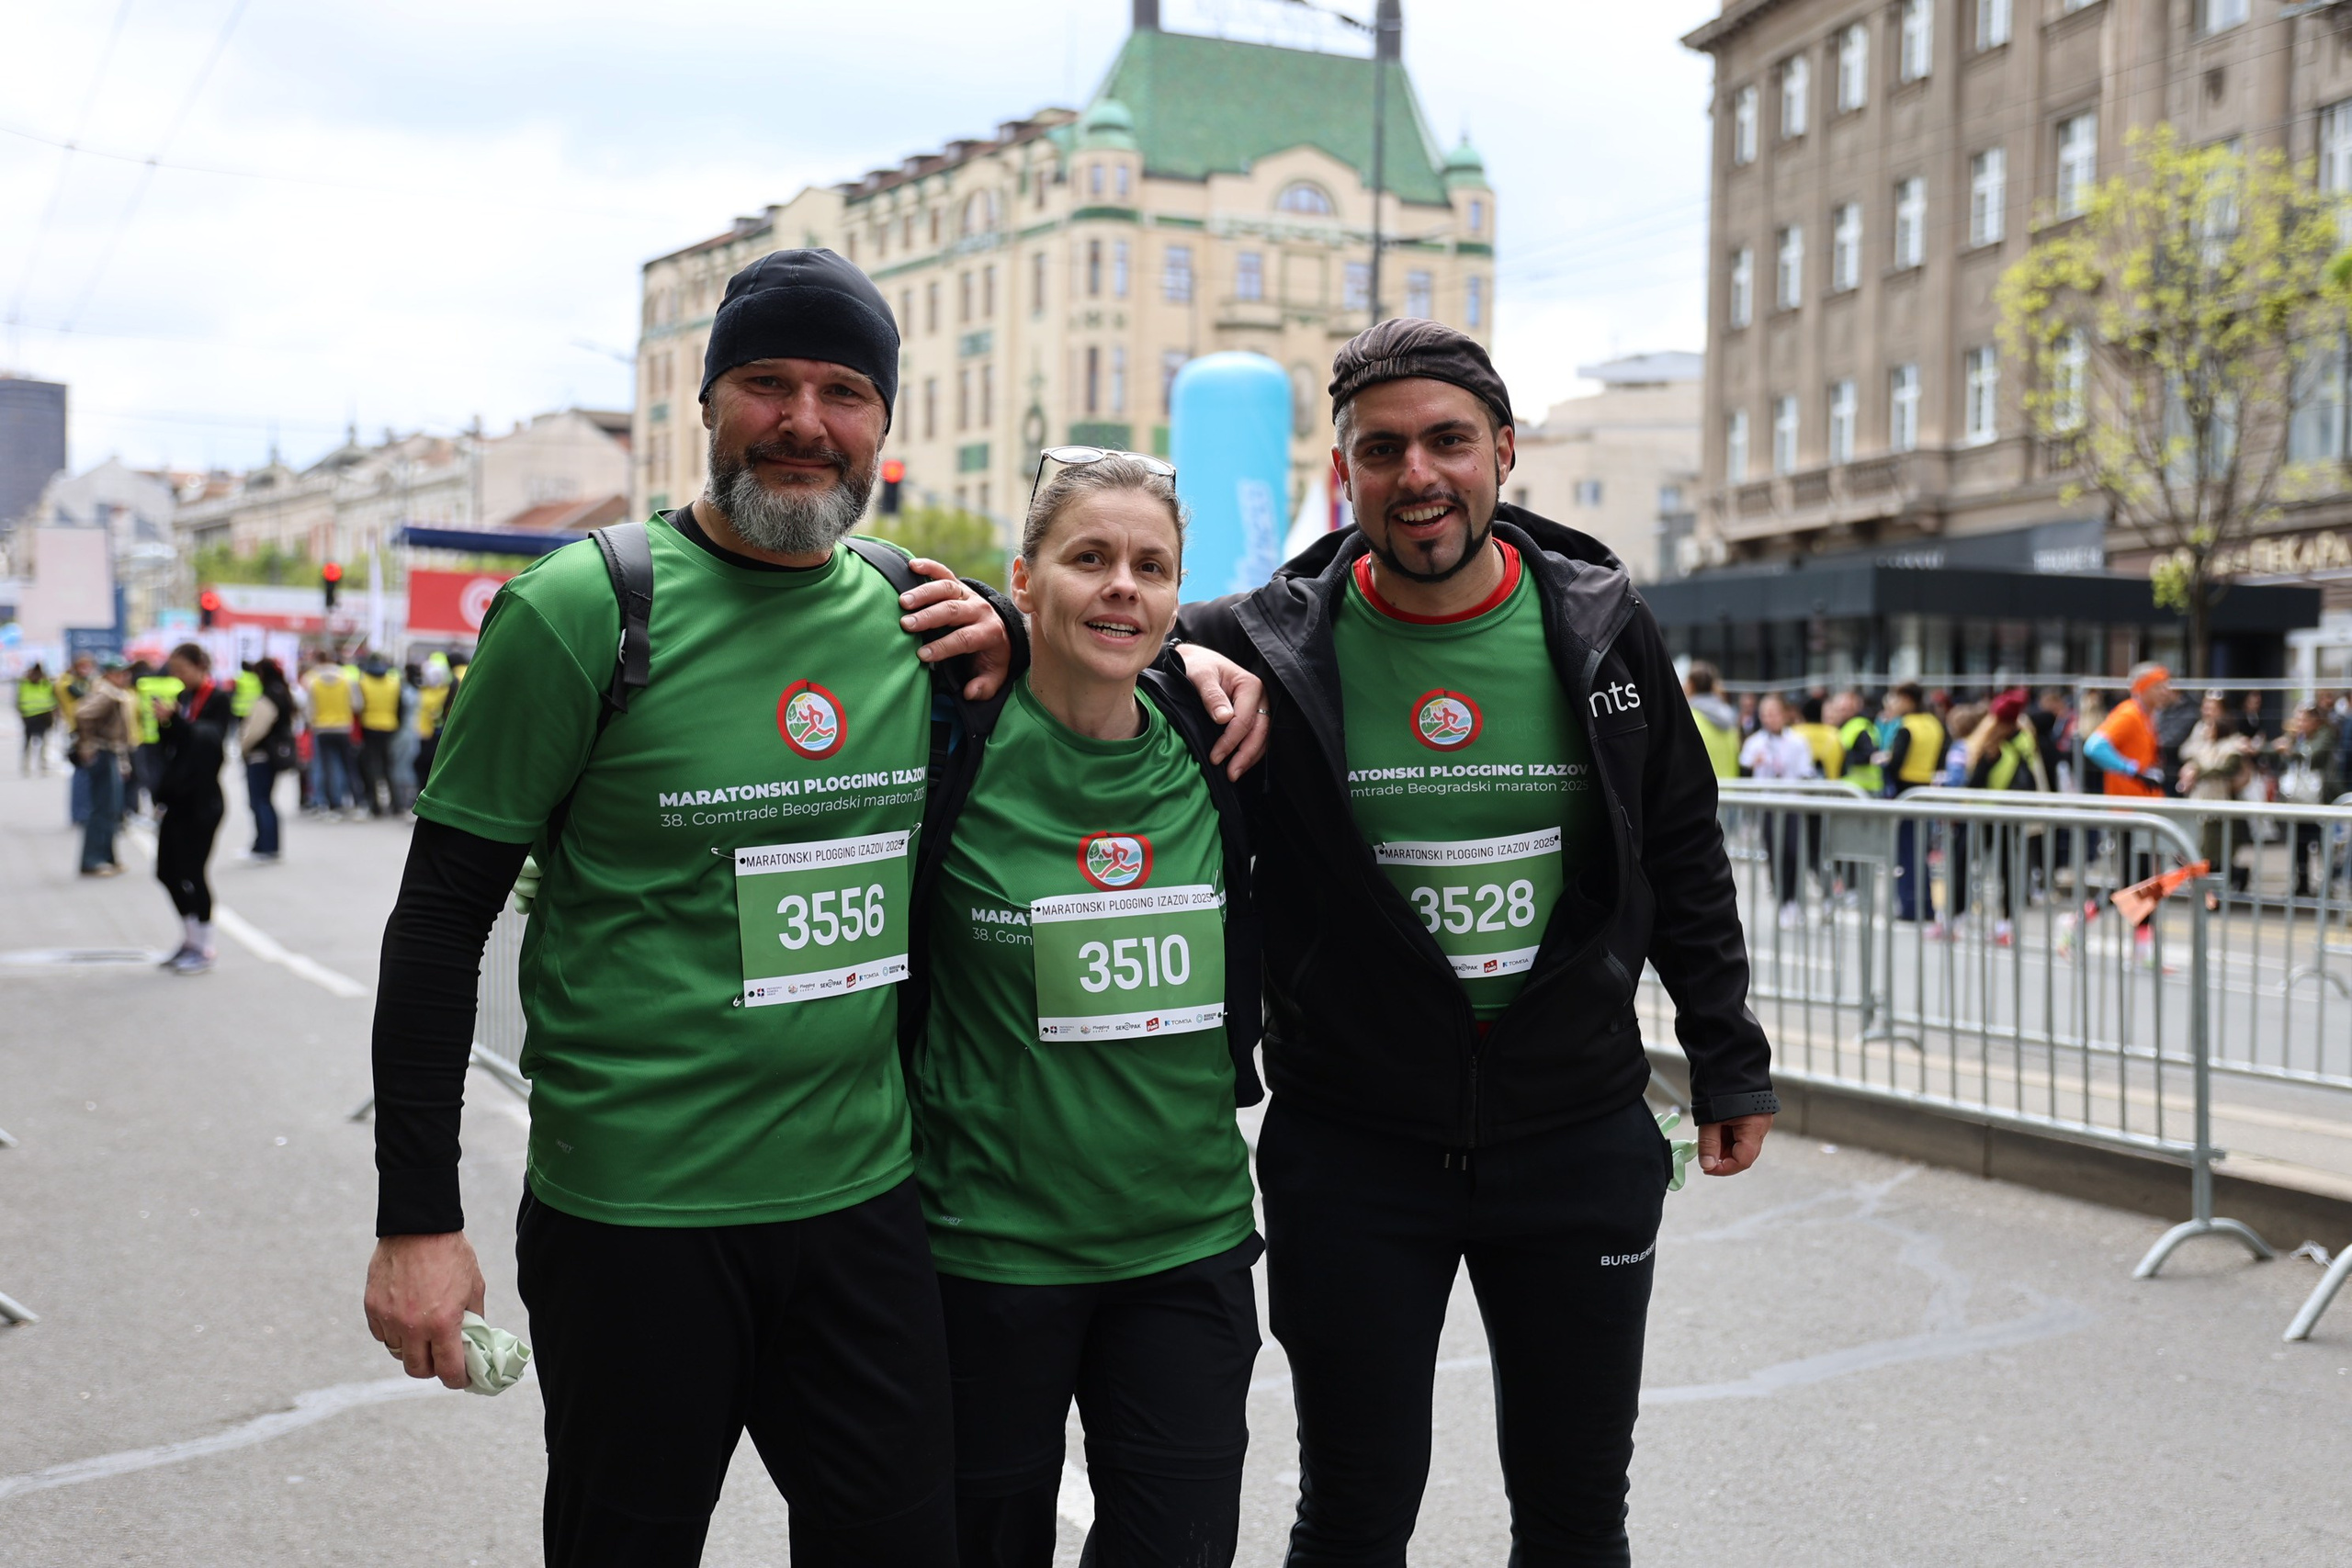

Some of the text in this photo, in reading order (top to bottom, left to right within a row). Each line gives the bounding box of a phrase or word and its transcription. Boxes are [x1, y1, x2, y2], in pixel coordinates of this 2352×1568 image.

[1588, 681, 1641, 717] nts
[659, 766, 926, 807] MARATONSKI PLOGGING IZAZOV
[1347, 764, 1588, 782] ATONSKI PLOGGING IZAZOV
[1408, 781, 1491, 796] Beogradski
[1495, 782, 1557, 793] maraton
[1560, 780, 1589, 792] 2025
[661, 814, 687, 827] 38.
[692, 805, 778, 826] Comtrade
[783, 795, 860, 817] Beogradski
[864, 791, 912, 807] maraton
[746, 839, 903, 868] MARATONSKI PLOGGING IZAZOV 2025
[1385, 837, 1555, 861] MARATONSKI PLOGGING IZAZOV 2025
[777, 884, 885, 950] 3556
[1042, 901, 1105, 916] MARATONSKI
[1109, 897, 1153, 910] PLOGGING
[1158, 894, 1189, 907] IZAZOV
[1192, 892, 1212, 904] 2025
[1411, 879, 1535, 934] 3528
[972, 927, 992, 942] 38.
[1079, 934, 1190, 992] 3510
